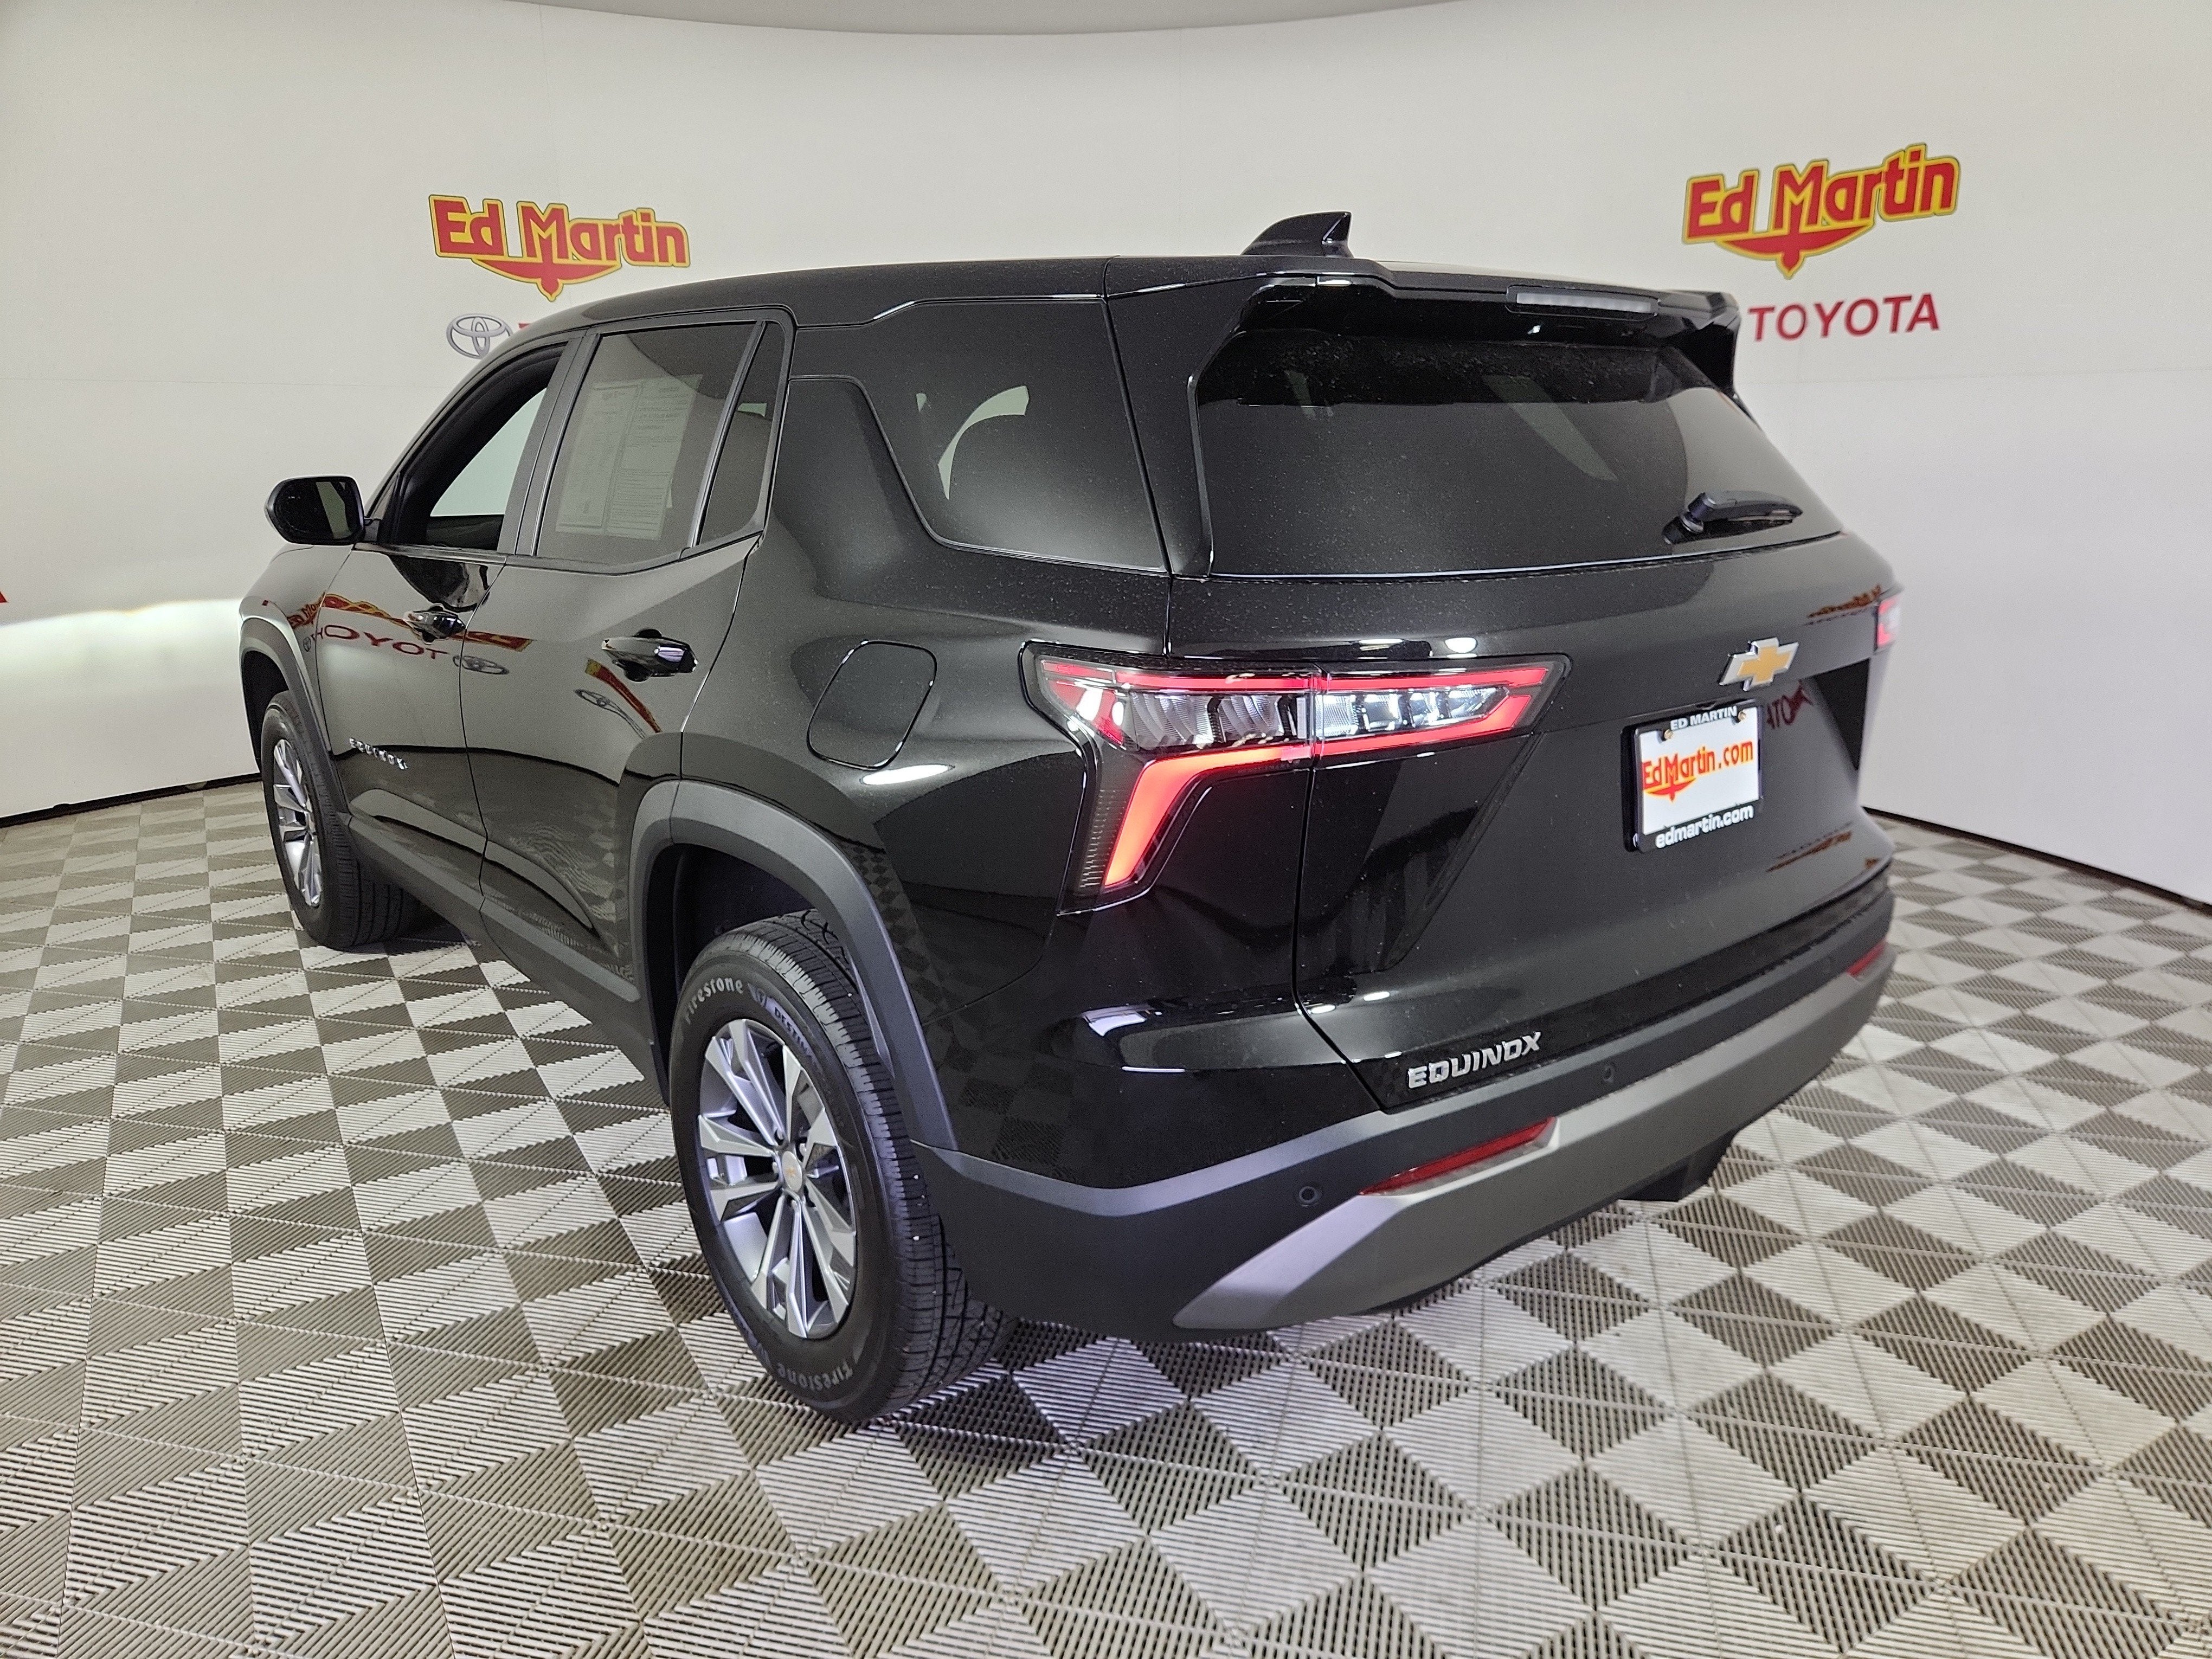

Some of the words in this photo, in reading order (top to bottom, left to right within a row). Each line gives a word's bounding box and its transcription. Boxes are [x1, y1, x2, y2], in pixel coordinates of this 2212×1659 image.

[1682, 169, 1759, 243] Ed
[1767, 143, 1960, 232] Martin
[429, 195, 508, 258] Ed
[517, 201, 690, 267] Martin
[1747, 293, 1939, 342] TOYOTA
[1670, 718, 1688, 731] ED
[1690, 705, 1738, 726] MARTIN
[1655, 805, 1754, 848] edmartin.com
[685, 976, 744, 1025] Firestone
[1408, 1031, 1541, 1089] EQUINOX
